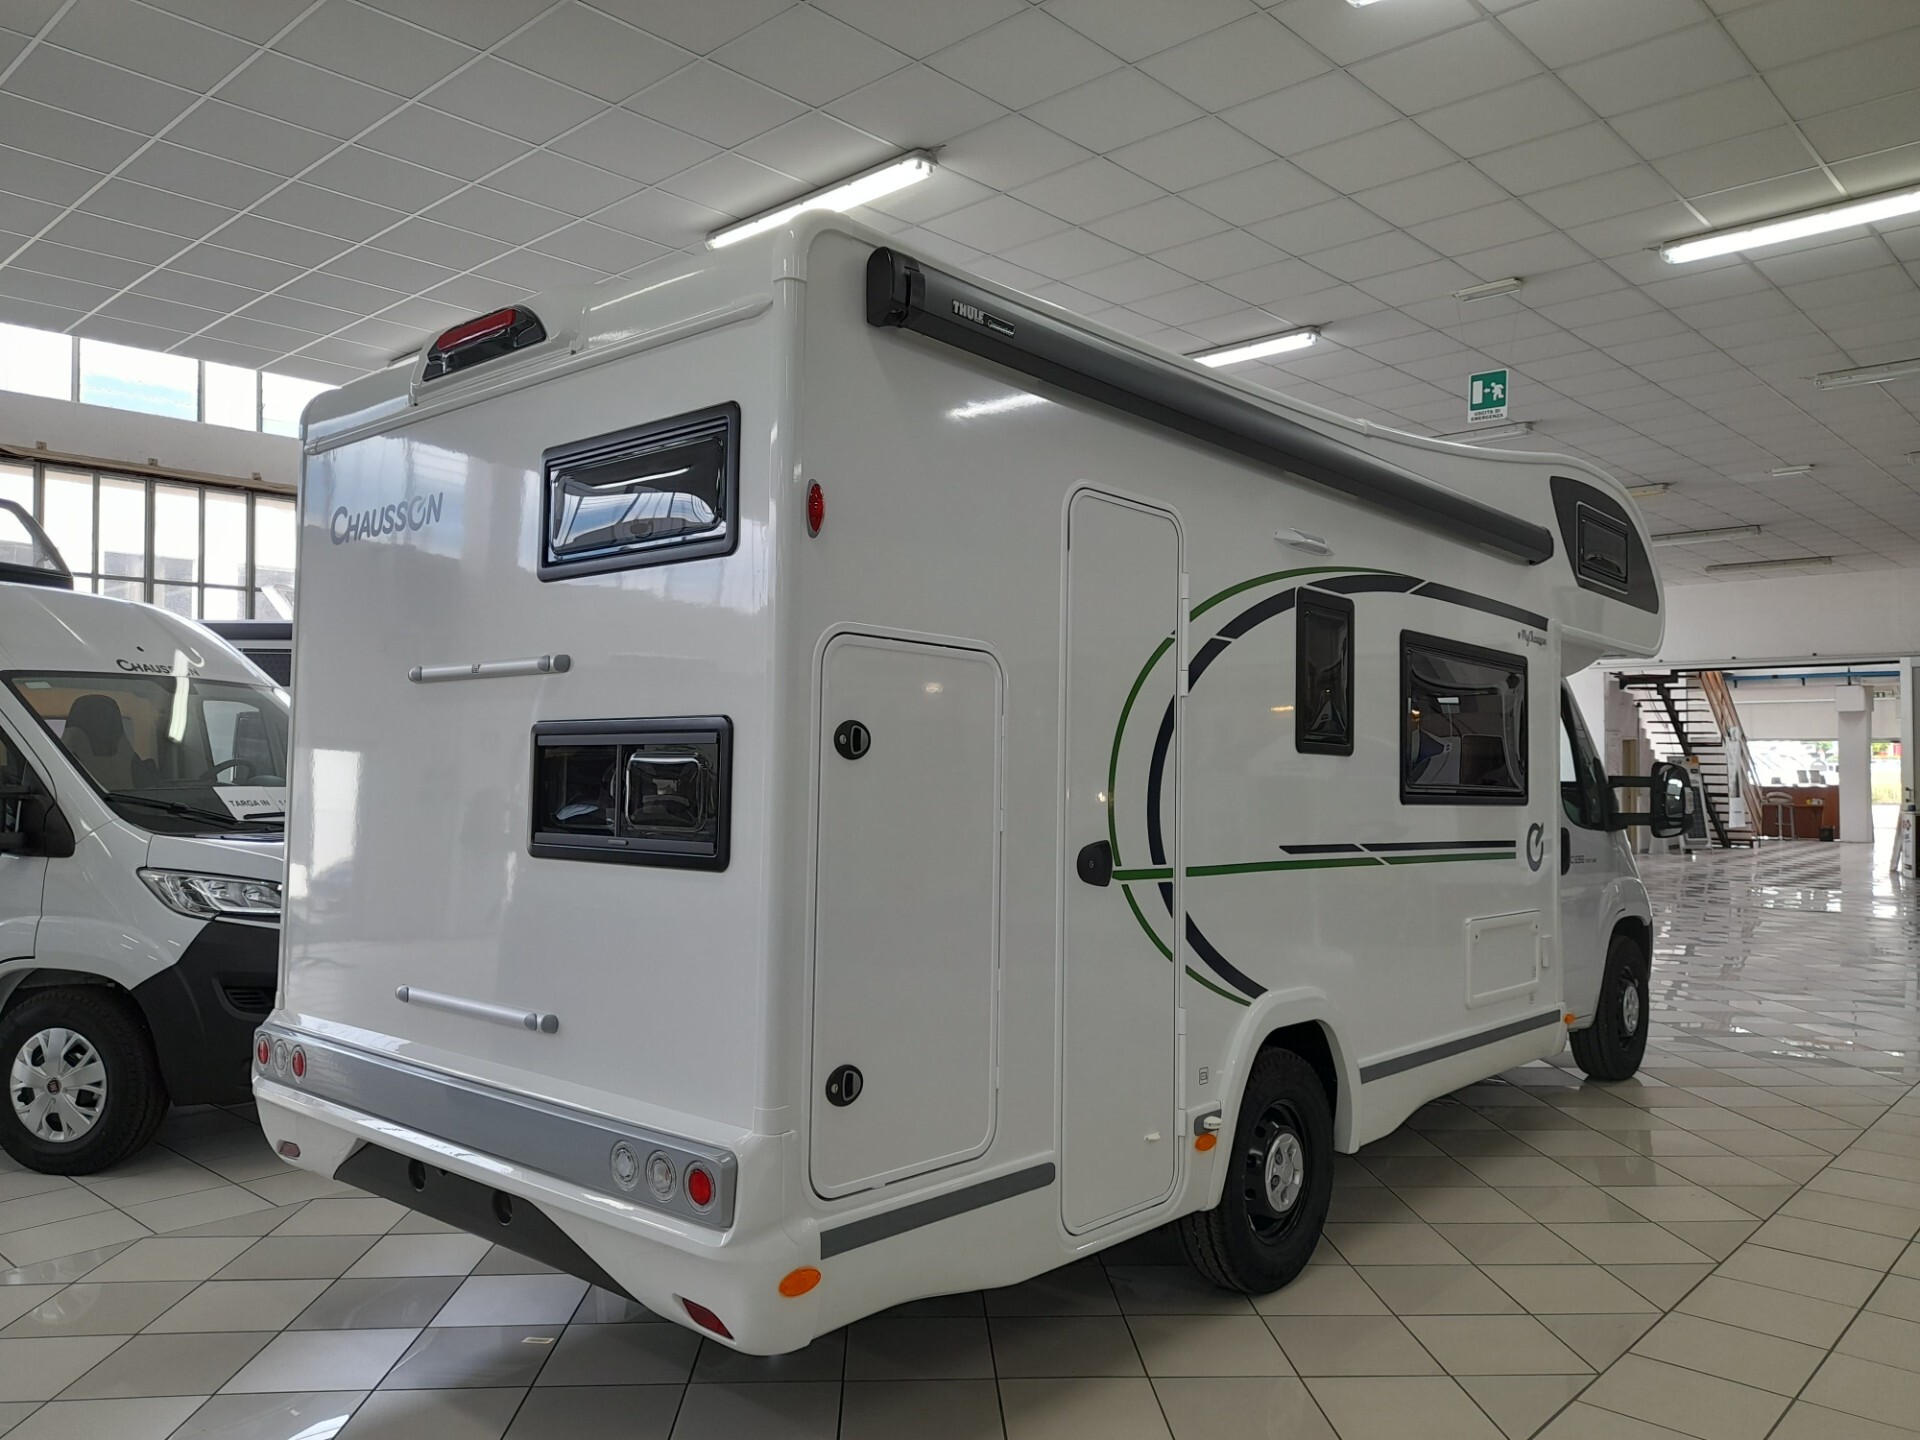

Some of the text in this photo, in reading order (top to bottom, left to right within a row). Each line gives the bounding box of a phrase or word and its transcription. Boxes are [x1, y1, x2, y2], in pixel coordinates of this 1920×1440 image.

[953, 300, 984, 325] THULE
[331, 492, 443, 545] CHAUSSON
[116, 659, 200, 676] CHAUSN
